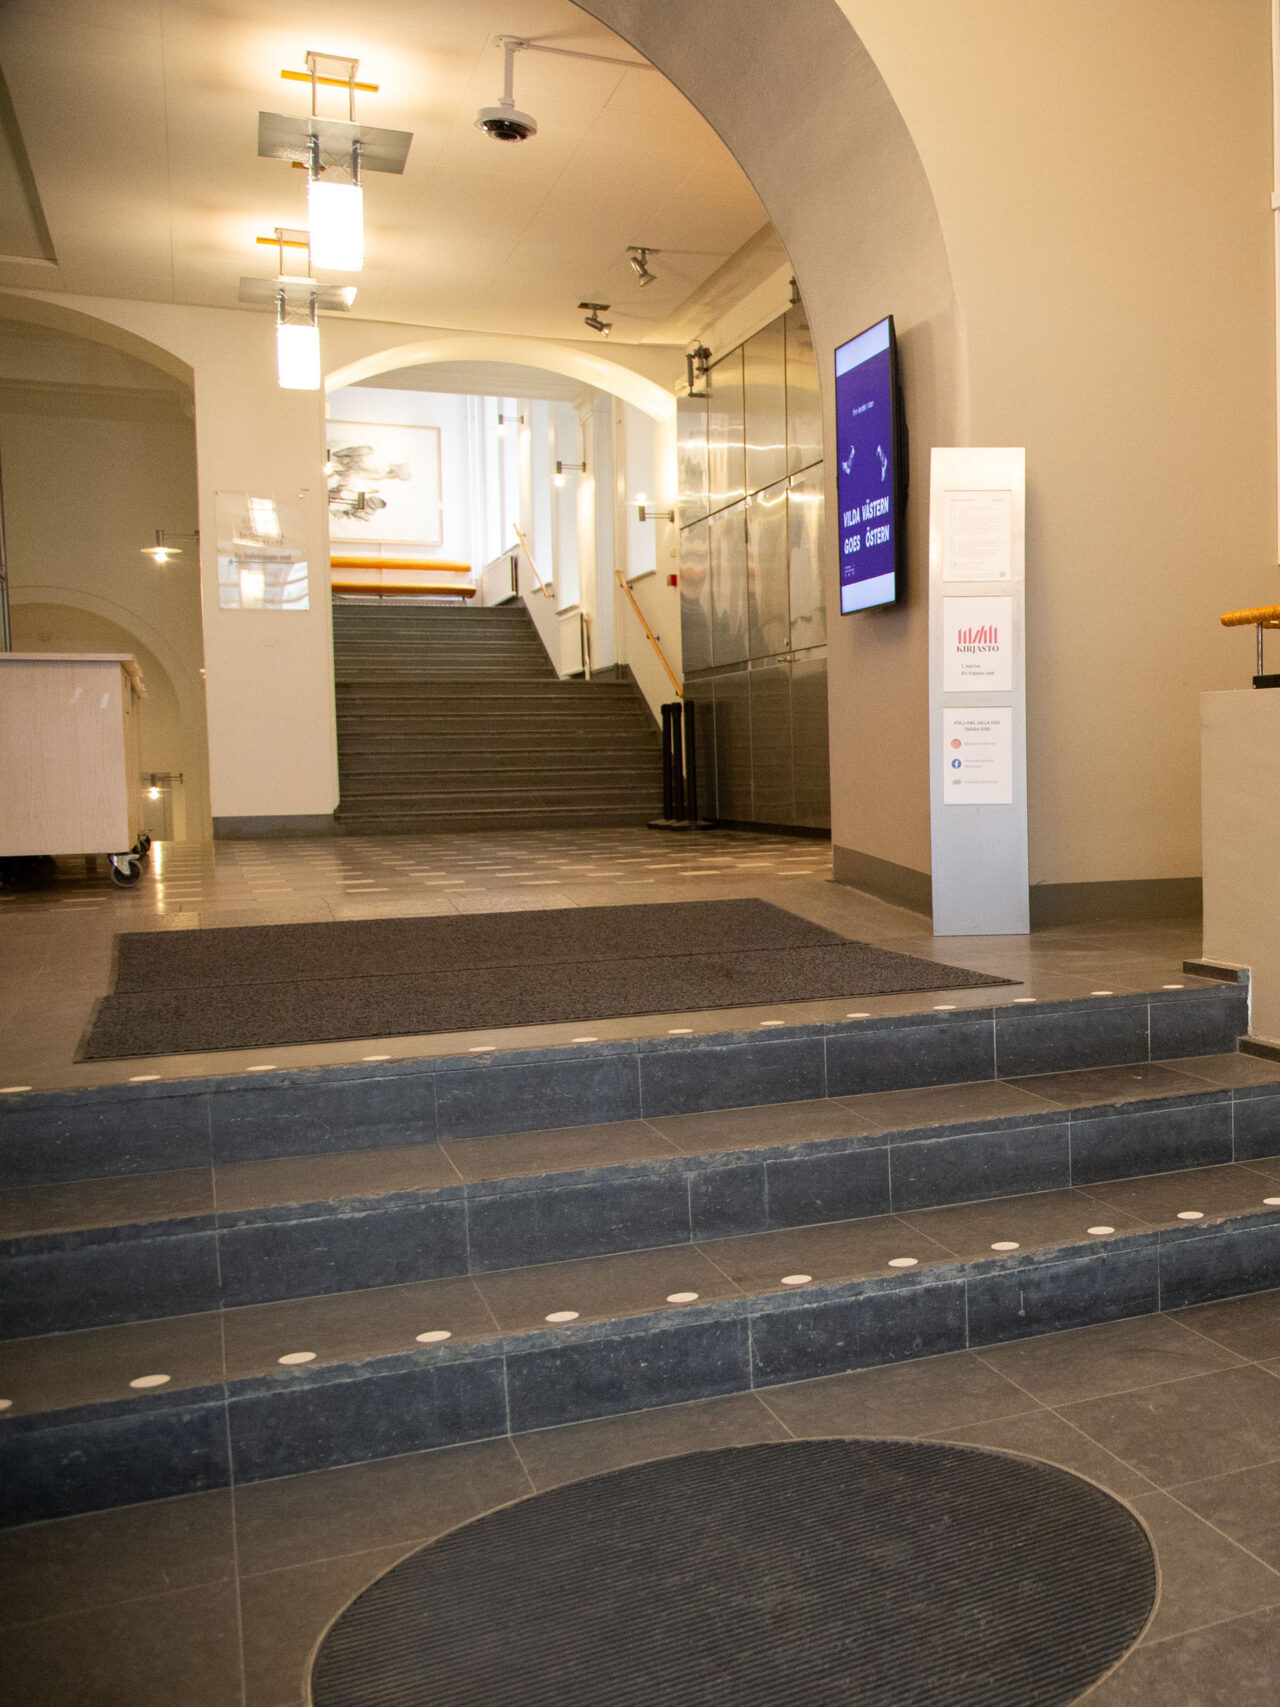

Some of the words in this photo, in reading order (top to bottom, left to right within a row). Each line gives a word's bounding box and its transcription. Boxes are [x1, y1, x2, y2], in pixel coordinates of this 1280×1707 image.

[843, 507, 860, 528] VILDA
[862, 496, 889, 521] VÄSTERN
[844, 534, 861, 554] GOES
[865, 524, 890, 548] ÖSTERN
[956, 645, 1000, 654] KIRJASTO
